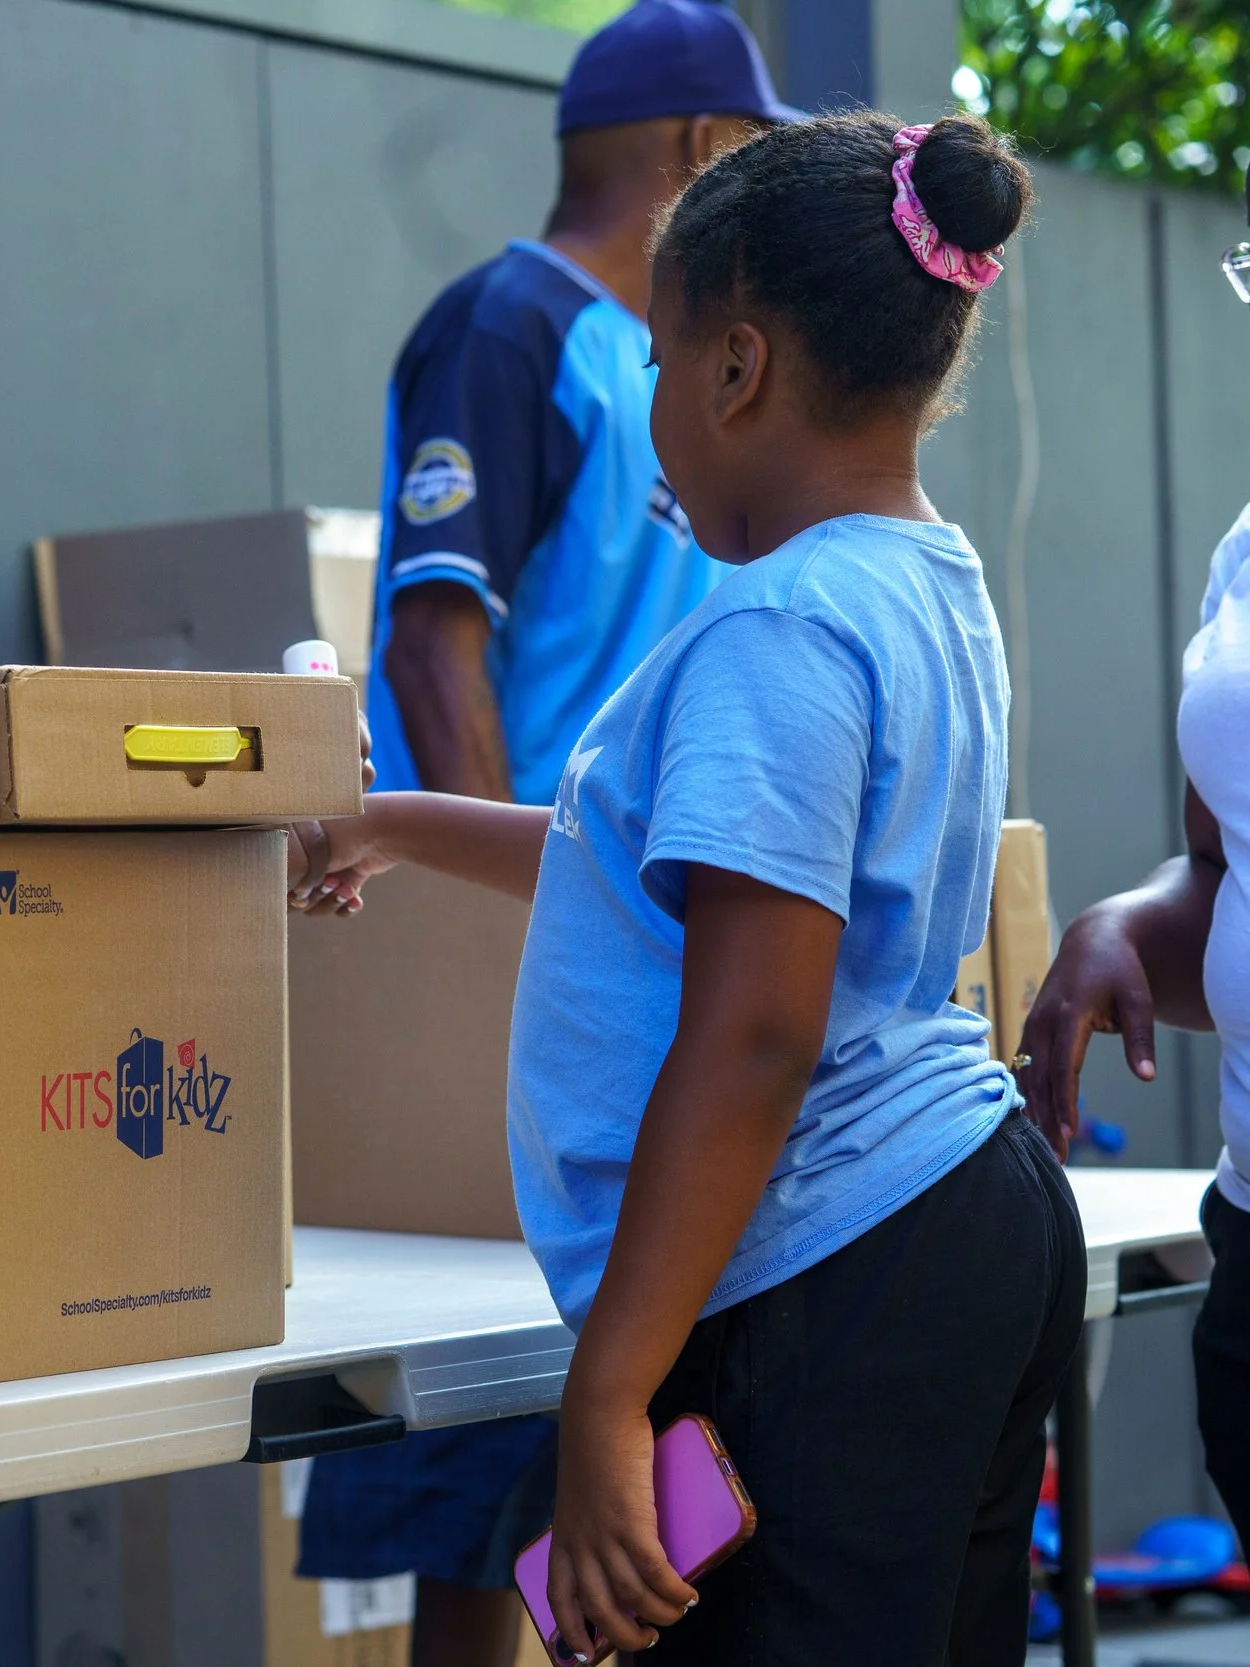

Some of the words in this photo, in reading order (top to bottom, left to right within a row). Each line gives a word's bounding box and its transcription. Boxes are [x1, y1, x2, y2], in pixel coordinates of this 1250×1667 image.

[18, 884, 53, 899] School
[41, 1070, 113, 1132] KITS
[121, 1062, 160, 1118] for
[60, 1284, 212, 1317] SchoolSpecialty.com/kitsforkidz
